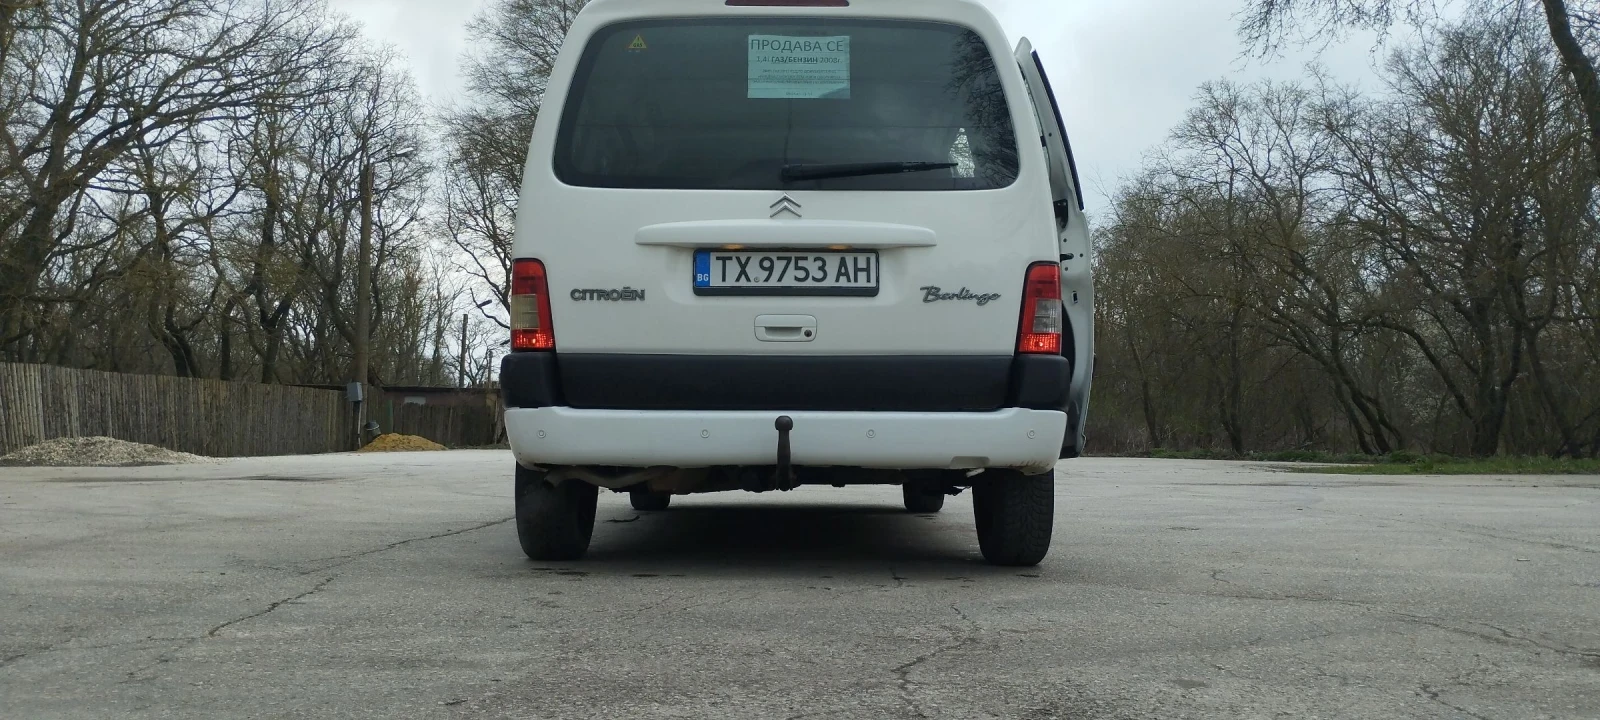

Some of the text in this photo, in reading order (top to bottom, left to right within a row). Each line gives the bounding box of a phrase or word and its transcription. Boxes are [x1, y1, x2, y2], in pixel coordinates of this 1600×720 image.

[750, 39, 844, 53] ПРОДАВА СЕ
[771, 56, 818, 64] ГАЗ/БЕНЗИН
[715, 256, 871, 283] TX 9753 AH
[697, 273, 709, 282] BG
[570, 286, 646, 301] CITROËN
[920, 286, 1001, 306] Berlingo
